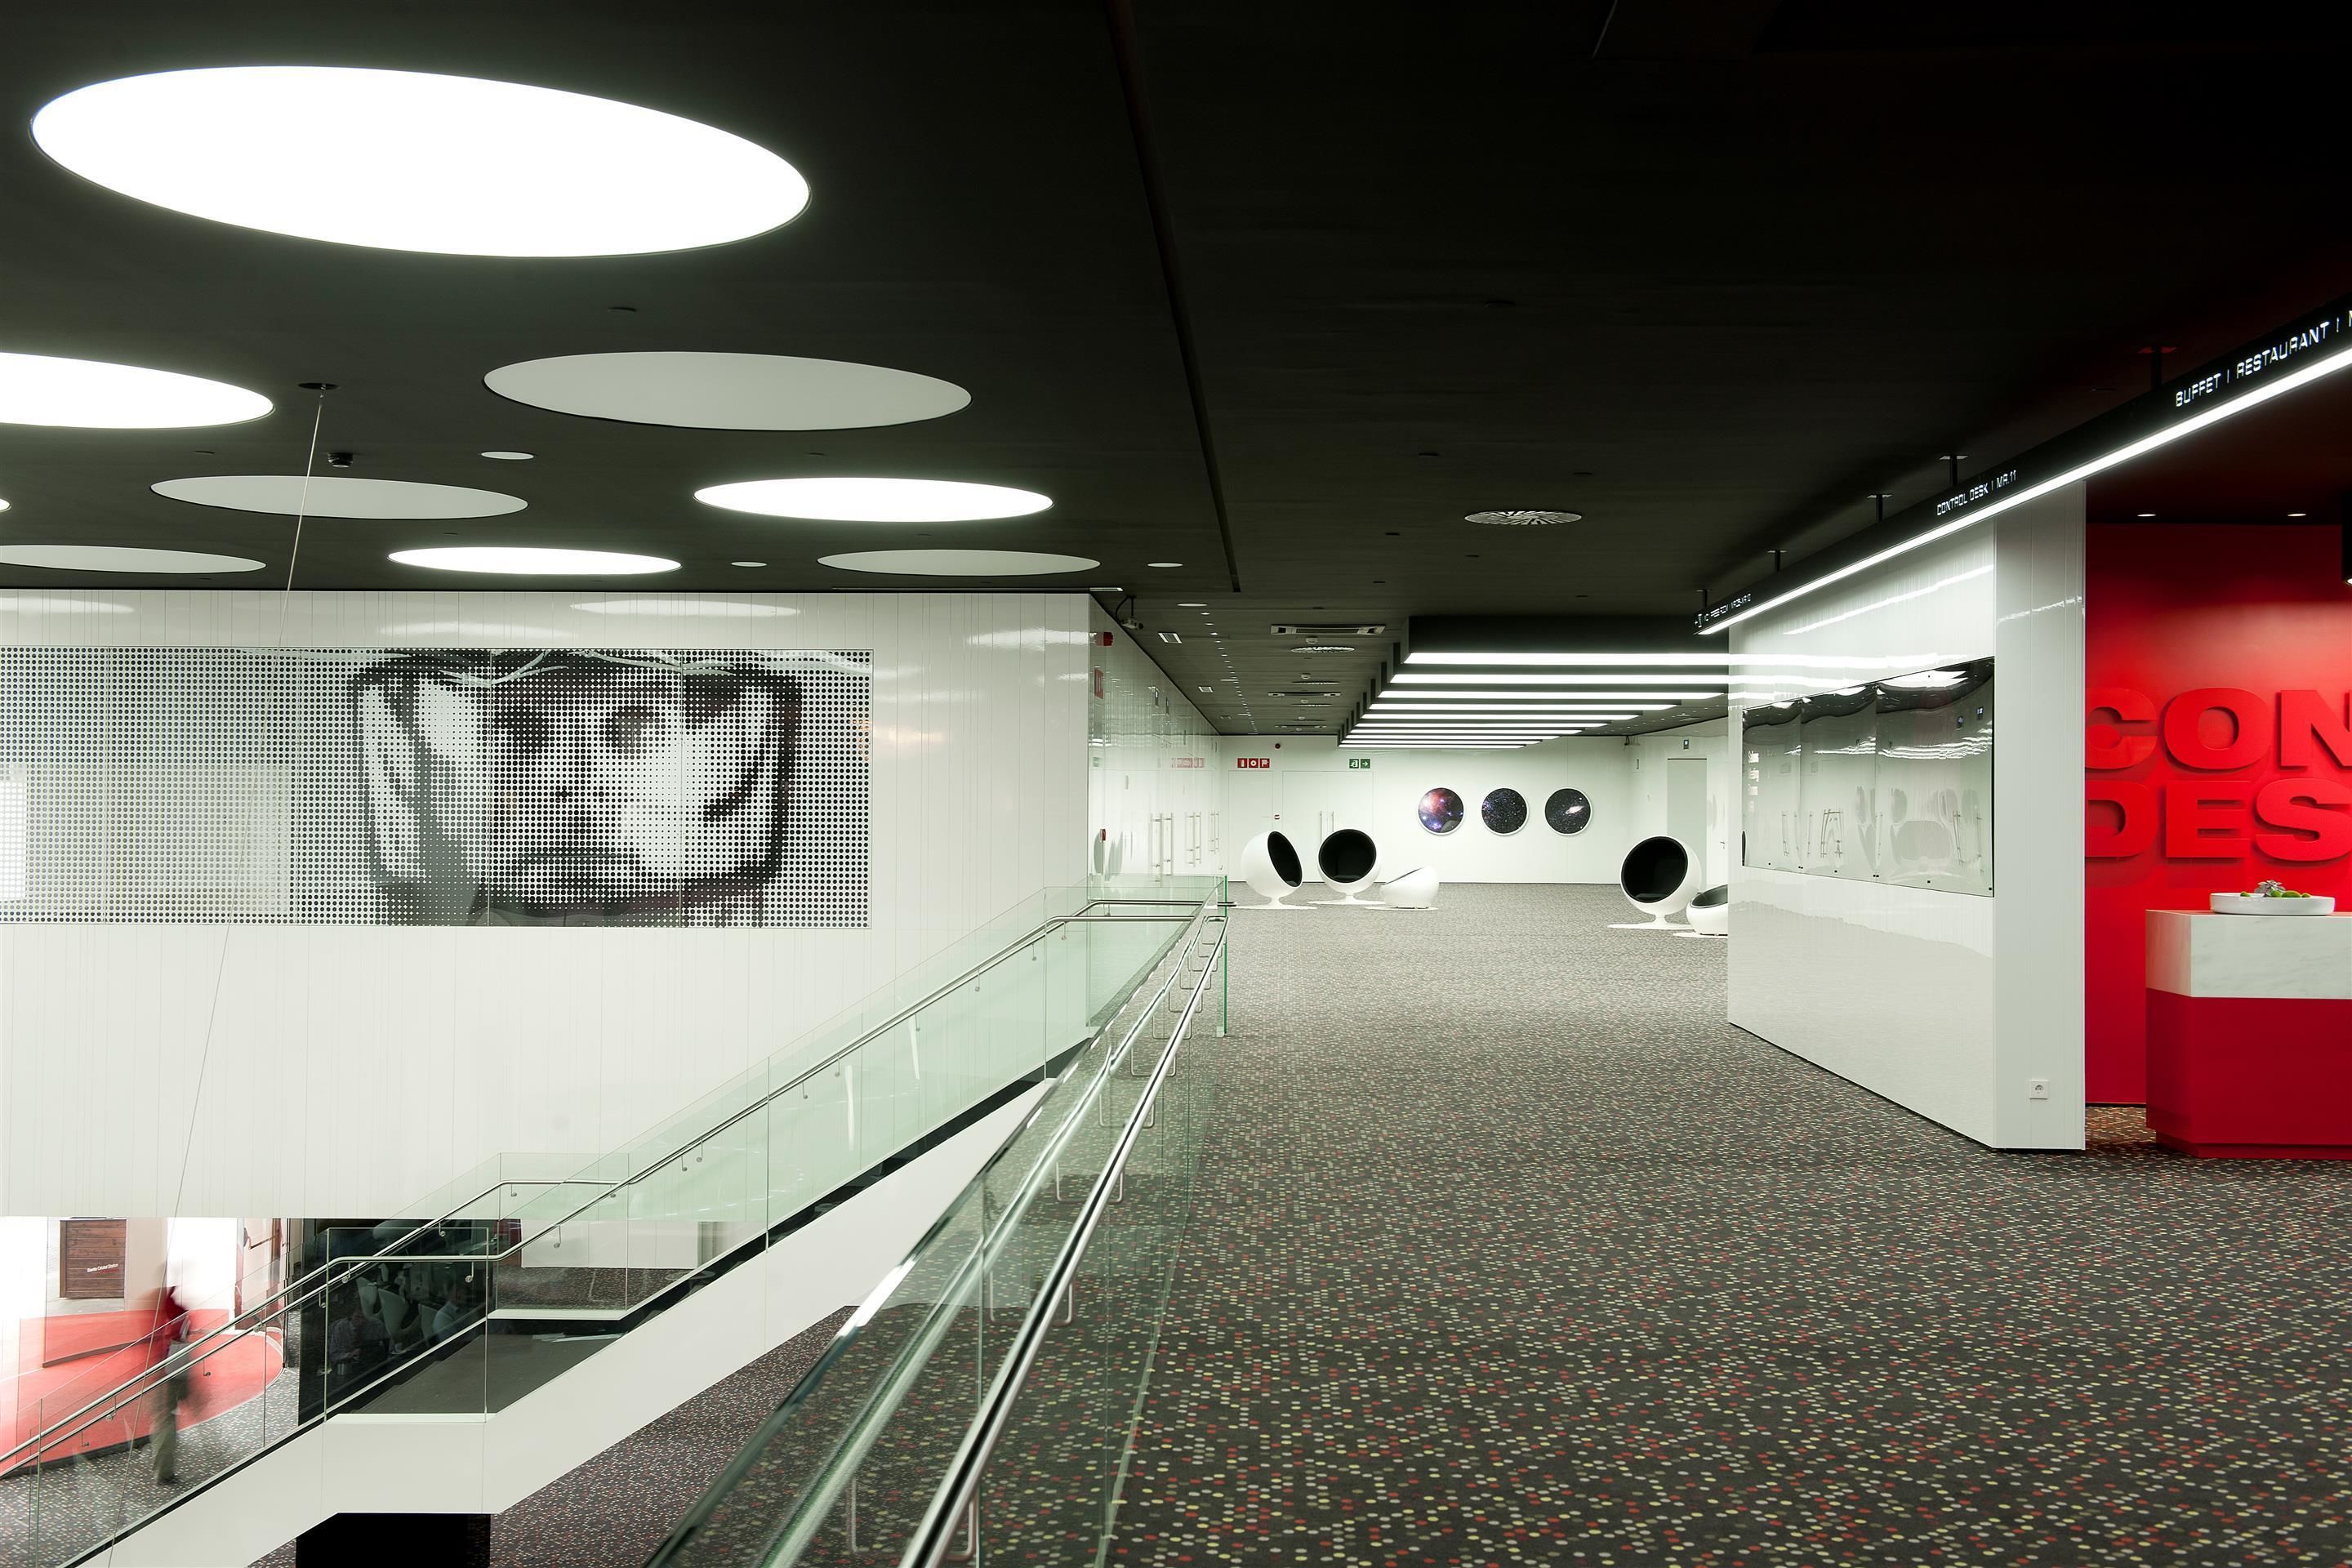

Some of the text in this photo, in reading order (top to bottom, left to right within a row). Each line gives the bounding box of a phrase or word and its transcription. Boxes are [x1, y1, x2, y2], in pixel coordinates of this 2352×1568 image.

[2176, 372, 2221, 407] BUFFET
[2236, 321, 2330, 379] RESTAURANT
[1936, 492, 1968, 516] CONTROL
[1969, 483, 1989, 501] DESK
[2085, 687, 2352, 770] CON
[2085, 777, 2352, 862] DES
